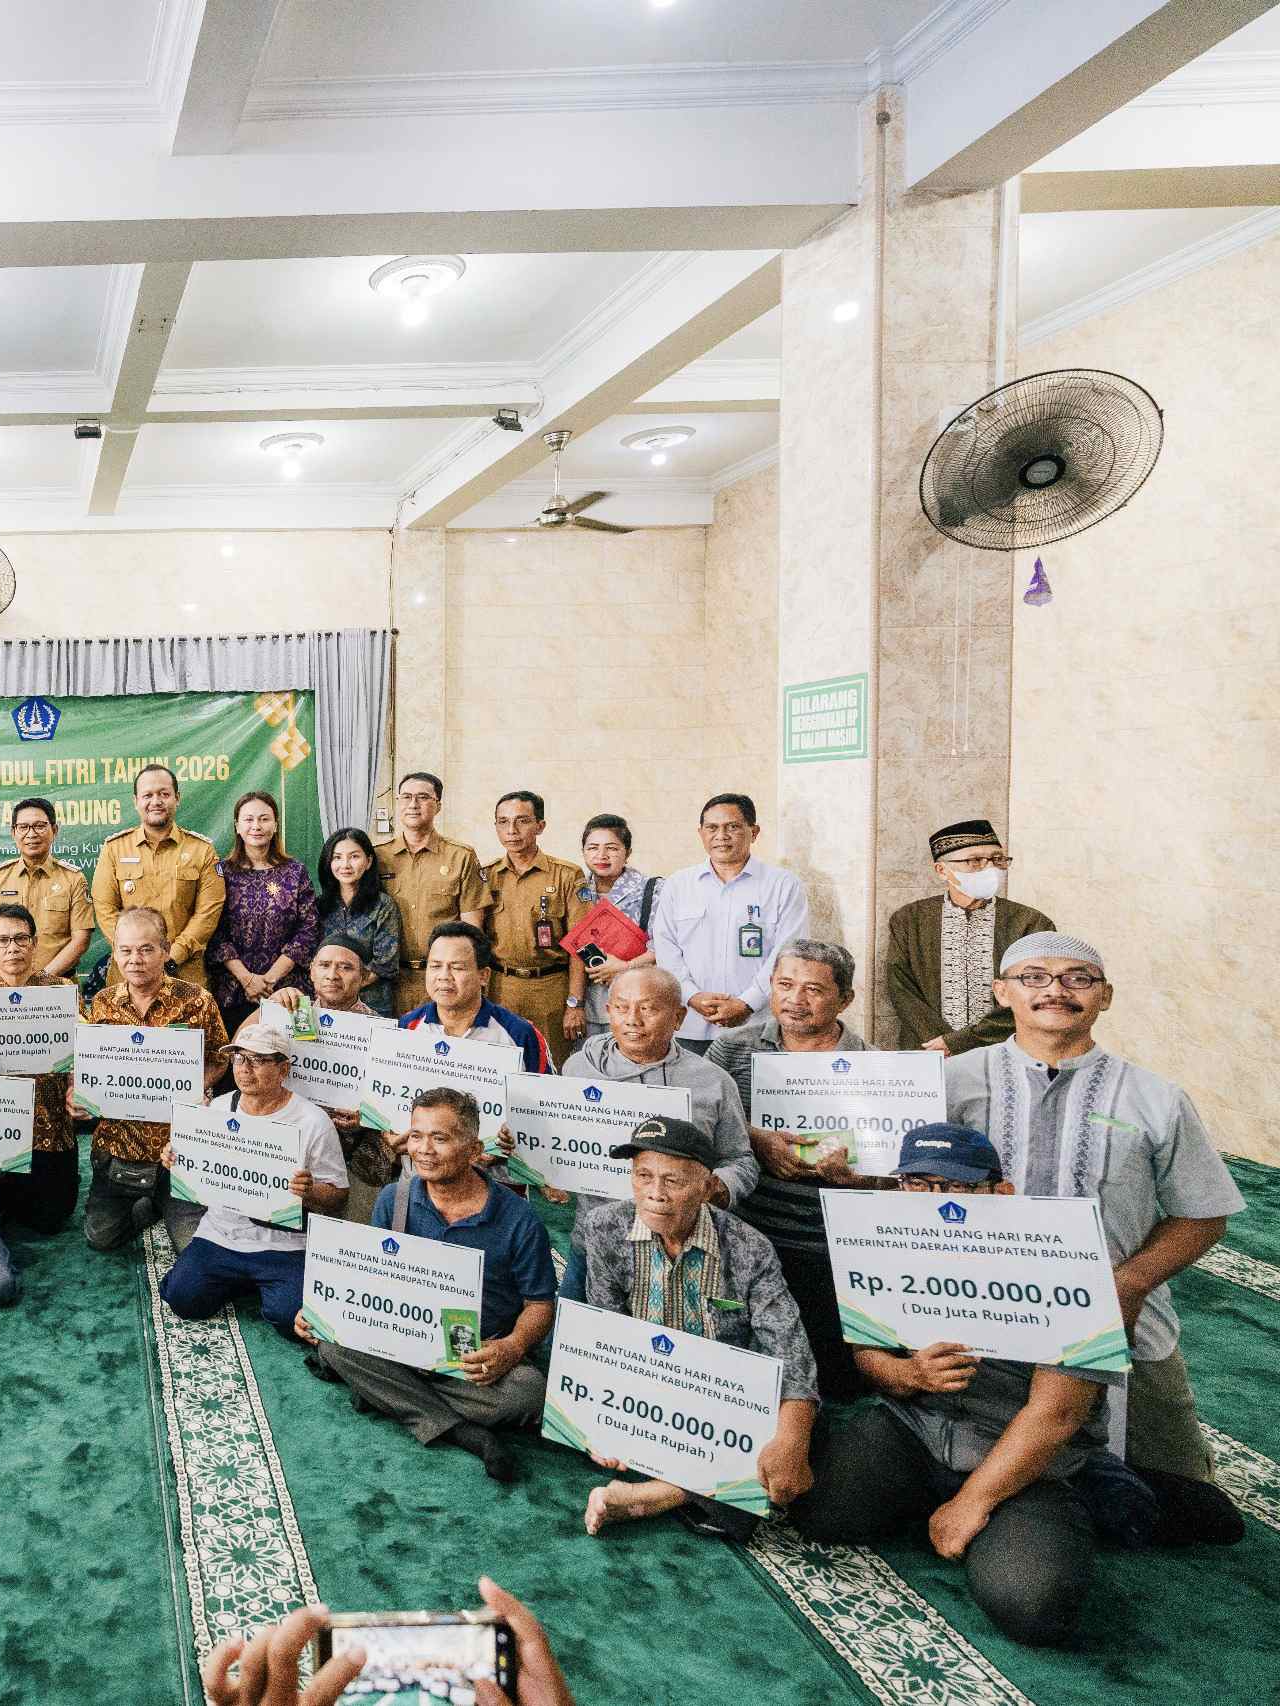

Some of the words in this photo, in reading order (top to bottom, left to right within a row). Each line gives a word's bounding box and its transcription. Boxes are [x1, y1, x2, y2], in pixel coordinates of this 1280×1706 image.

[45, 758, 96, 785] FITRI
[176, 754, 230, 782] 2026
[55, 799, 121, 825] ADUNG
[291, 1055, 366, 1081] 2.000.000,
[82, 1074, 102, 1088] Rp.
[107, 1075, 192, 1092] 2.000.000,00
[372, 1080, 395, 1099] Rp.
[483, 1077, 503, 1086] BADU
[511, 1108, 559, 1119] PEMERINTAH
[562, 1114, 593, 1123] DAERAH
[596, 1118, 639, 1128] KABUPAT
[539, 1101, 581, 1111] BANTUAN
[585, 1106, 610, 1115] UANG
[614, 1109, 636, 1118] HARI
[762, 1115, 790, 1133] Rp.
[517, 1132, 545, 1151] Rp.
[551, 1136, 616, 1157] 2.000.
[178, 1155, 198, 1172] Rp.
[203, 1160, 289, 1191] 2.000.000,00
[557, 1157, 576, 1167] Dua
[578, 1161, 599, 1170] Juta
[603, 1164, 632, 1175] Rupia
[206, 1178, 219, 1187] Dua
[221, 1182, 236, 1191] Juta
[239, 1186, 264, 1198] Rupiah
[876, 1226, 940, 1237] BANTUAN
[944, 1230, 983, 1240] UANG
[987, 1232, 1021, 1242] HARI
[1025, 1234, 1064, 1244] RAYA
[836, 1238, 908, 1249] PEMERINTAH
[911, 1242, 959, 1253] DAERAH
[962, 1245, 1038, 1257] KABUPATEN
[1041, 1250, 1100, 1261] BADUNG
[311, 1253, 356, 1270] PEMERINTAH
[359, 1265, 388, 1277] DAERAH
[391, 1272, 437, 1289] KABUPATEN
[440, 1284, 475, 1298] BADUNG
[339, 1249, 378, 1264] BANTUAN
[381, 1258, 406, 1270] UANG
[409, 1265, 429, 1276] HARI
[432, 1270, 455, 1282] RAYA
[848, 1272, 893, 1297] Rp.
[900, 1275, 1093, 1308] 2.000.000,00
[313, 1280, 339, 1304] Rp.
[346, 1288, 442, 1329] 2.000.000,
[912, 1304, 942, 1316] Dua
[944, 1307, 978, 1319] Juta
[982, 1310, 1040, 1325] Rupiah
[349, 1312, 367, 1323] Dua
[369, 1317, 389, 1330] Juta
[393, 1323, 427, 1340] Rupiah
[559, 1343, 617, 1368] PEMERINTAH
[620, 1362, 658, 1381] DAERAH
[661, 1375, 721, 1400] KABUPATEN
[724, 1394, 771, 1416] BADUNG
[596, 1341, 646, 1363] BANTUAN
[650, 1358, 681, 1374] UANG
[685, 1368, 711, 1383] HARI
[716, 1377, 746, 1394] RAYA
[560, 1375, 594, 1405] Rp.
[602, 1388, 754, 1455] 2.000.000,00
[605, 1416, 629, 1432] Dua
[631, 1425, 657, 1442] Juta
[661, 1435, 706, 1459] Rupiah
